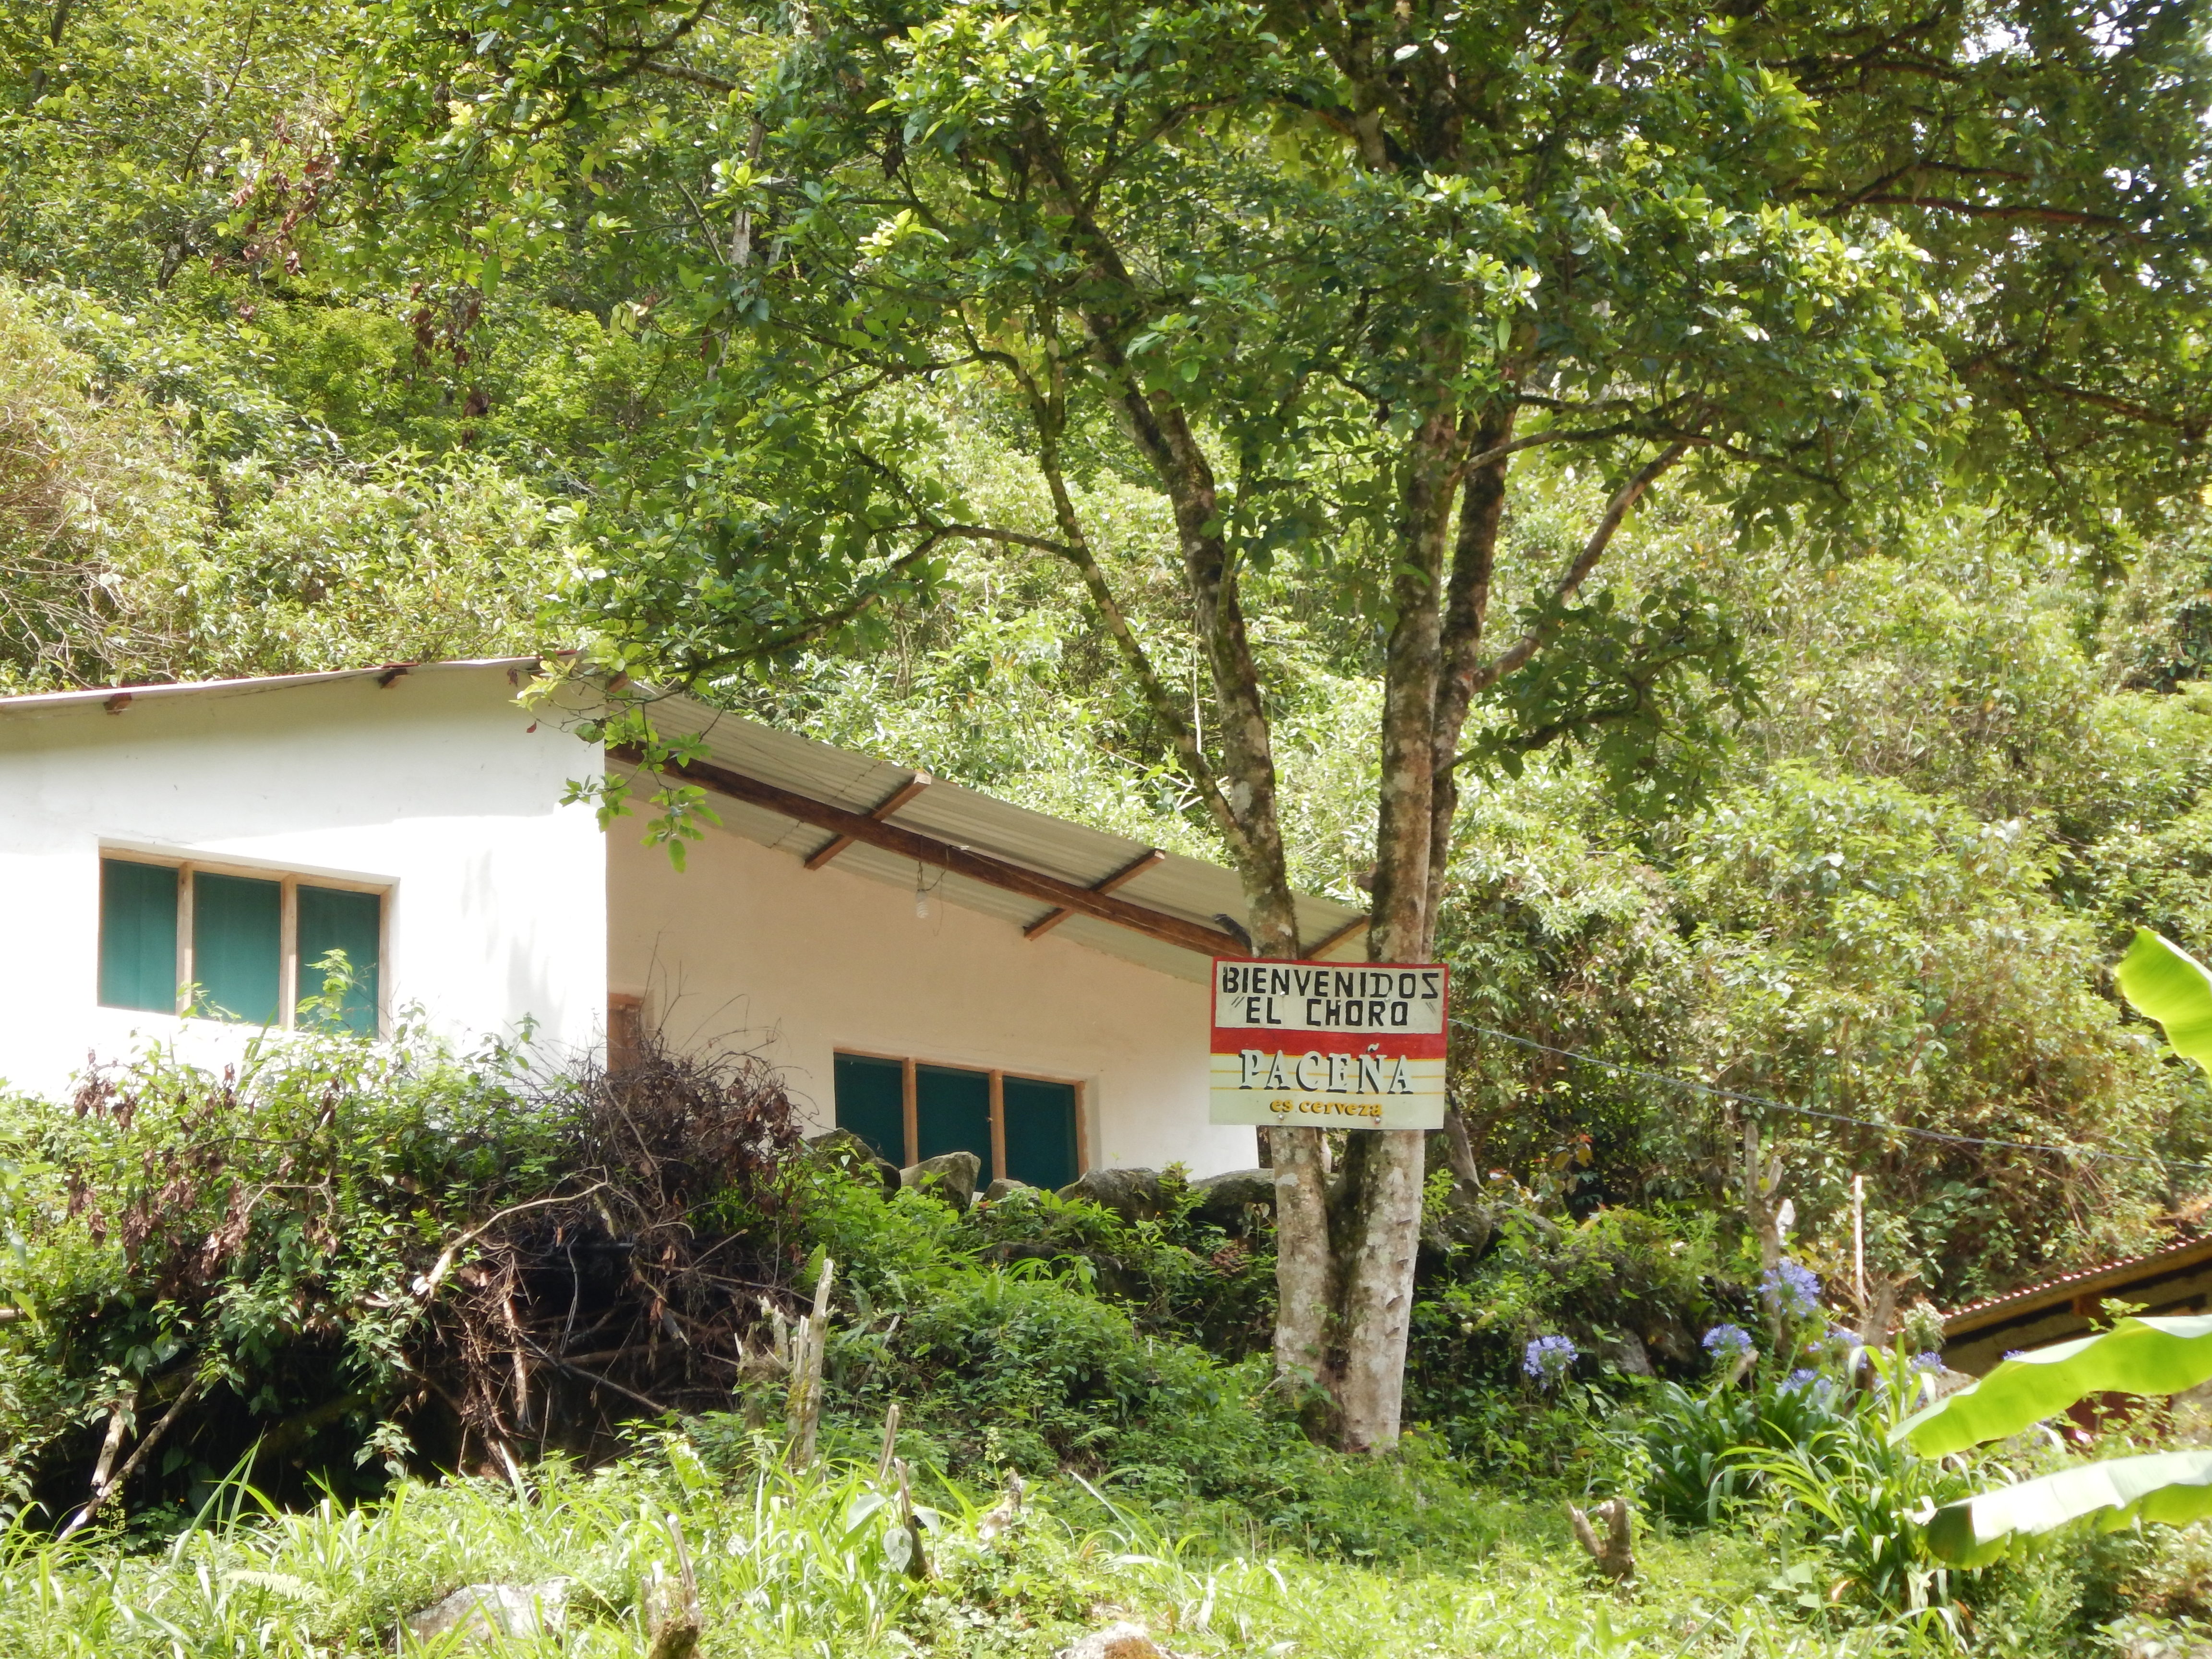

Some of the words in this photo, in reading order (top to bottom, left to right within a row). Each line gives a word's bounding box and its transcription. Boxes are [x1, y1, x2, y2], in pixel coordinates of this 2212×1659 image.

[1223, 967, 1439, 999] BIENVENIDOS
[1238, 1043, 1414, 1094] PACEÑA
[1270, 1099, 1294, 1112] es
[1299, 1100, 1383, 1117] cerveza
